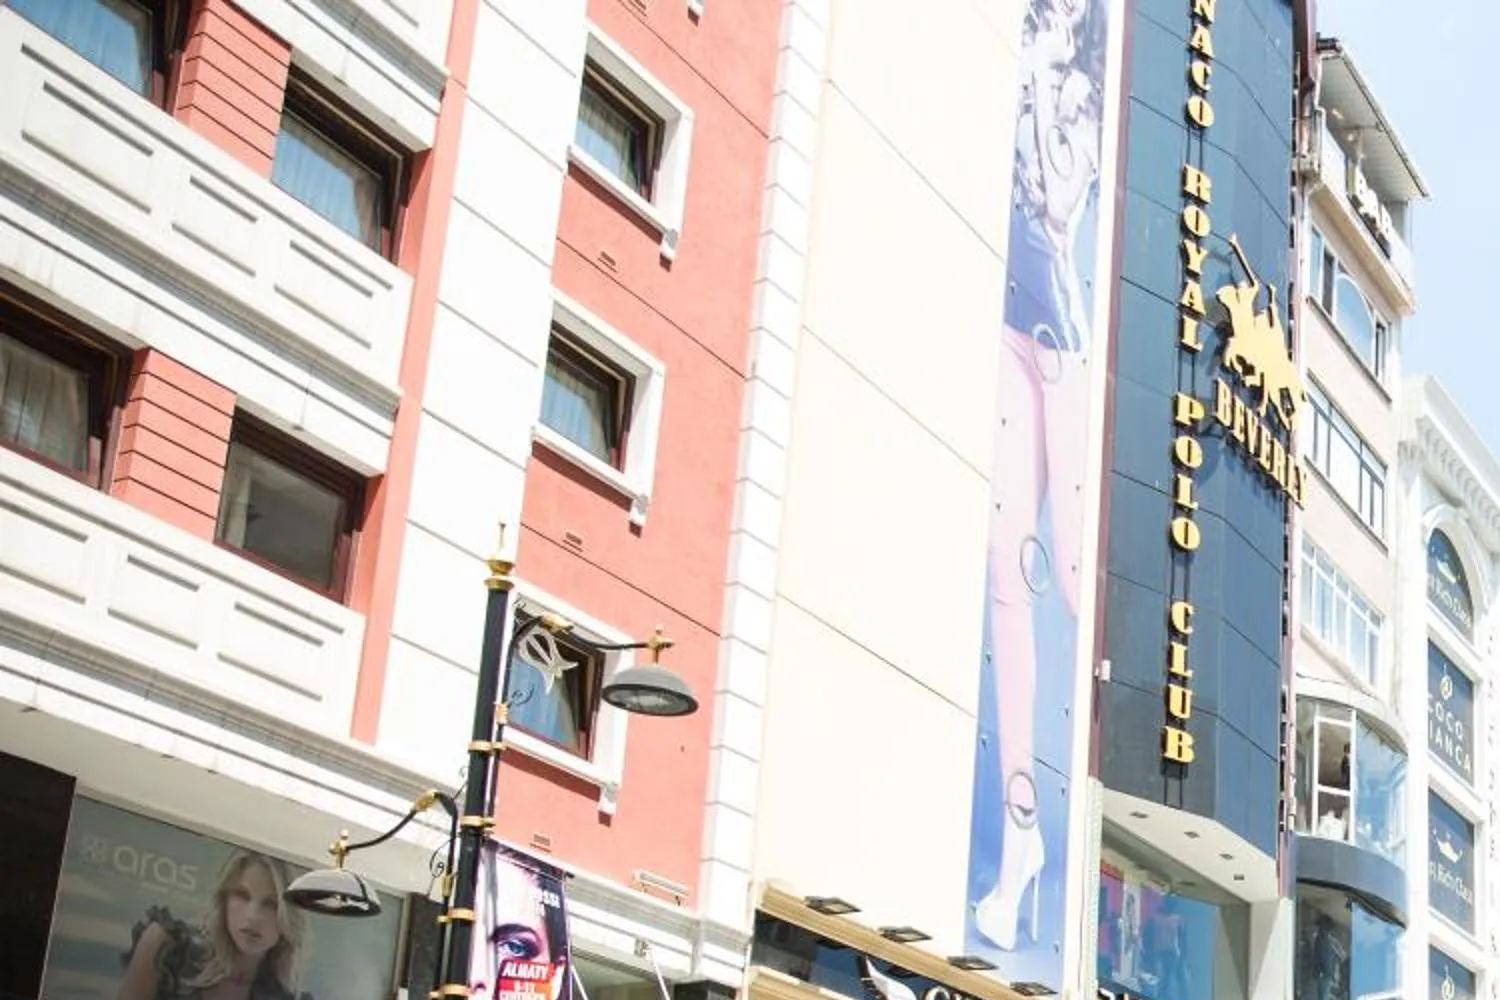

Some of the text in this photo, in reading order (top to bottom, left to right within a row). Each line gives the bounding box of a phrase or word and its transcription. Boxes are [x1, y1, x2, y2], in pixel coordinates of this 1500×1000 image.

[1179, 164, 1211, 354] ROYAL
[1171, 392, 1205, 553] POLO
[1215, 377, 1306, 508] BEVERLY
[1161, 600, 1195, 765] CLUB
[501, 961, 550, 979] ALMATY
